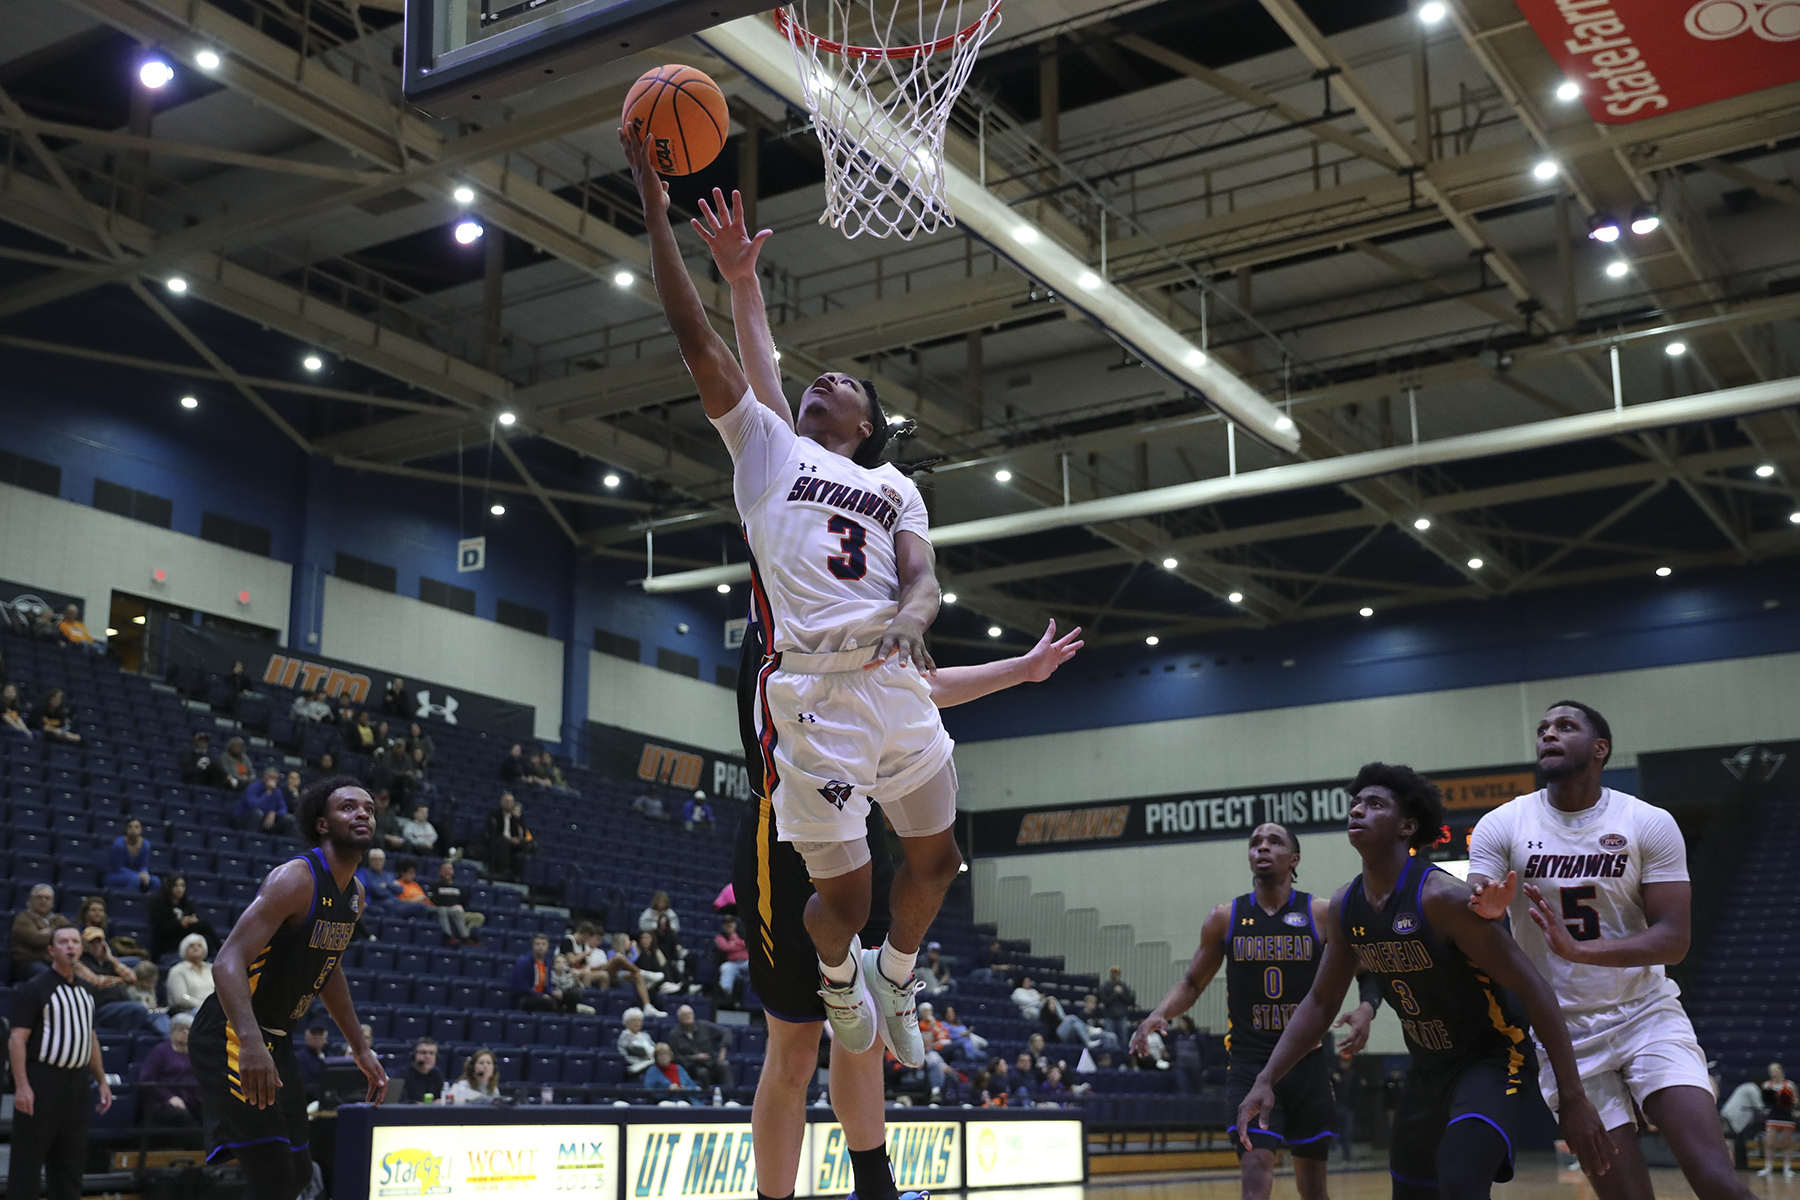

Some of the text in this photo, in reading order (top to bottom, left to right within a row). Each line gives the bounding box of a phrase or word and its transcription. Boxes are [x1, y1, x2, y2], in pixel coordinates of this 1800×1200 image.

[786, 476, 898, 532] SKYHAWKS
[463, 549, 479, 567] D
[827, 514, 867, 581] 3
[637, 743, 704, 789] UTM
[1016, 805, 1130, 845] SKYHAWKS
[1145, 795, 1256, 834] PROTECT
[1261, 790, 1307, 824] THIS
[1524, 854, 1628, 879] SKYHAWKS
[1560, 886, 1601, 942] 5
[1233, 935, 1313, 961] MOREHEAD
[313, 956, 337, 989] 5
[1264, 966, 1283, 999] 0
[1391, 979, 1421, 1015] 3
[1252, 1003, 1299, 1030] STAT
[467, 1149, 539, 1176] WCMT
[556, 1141, 605, 1161] MIX
[635, 1132, 681, 1197] UT
